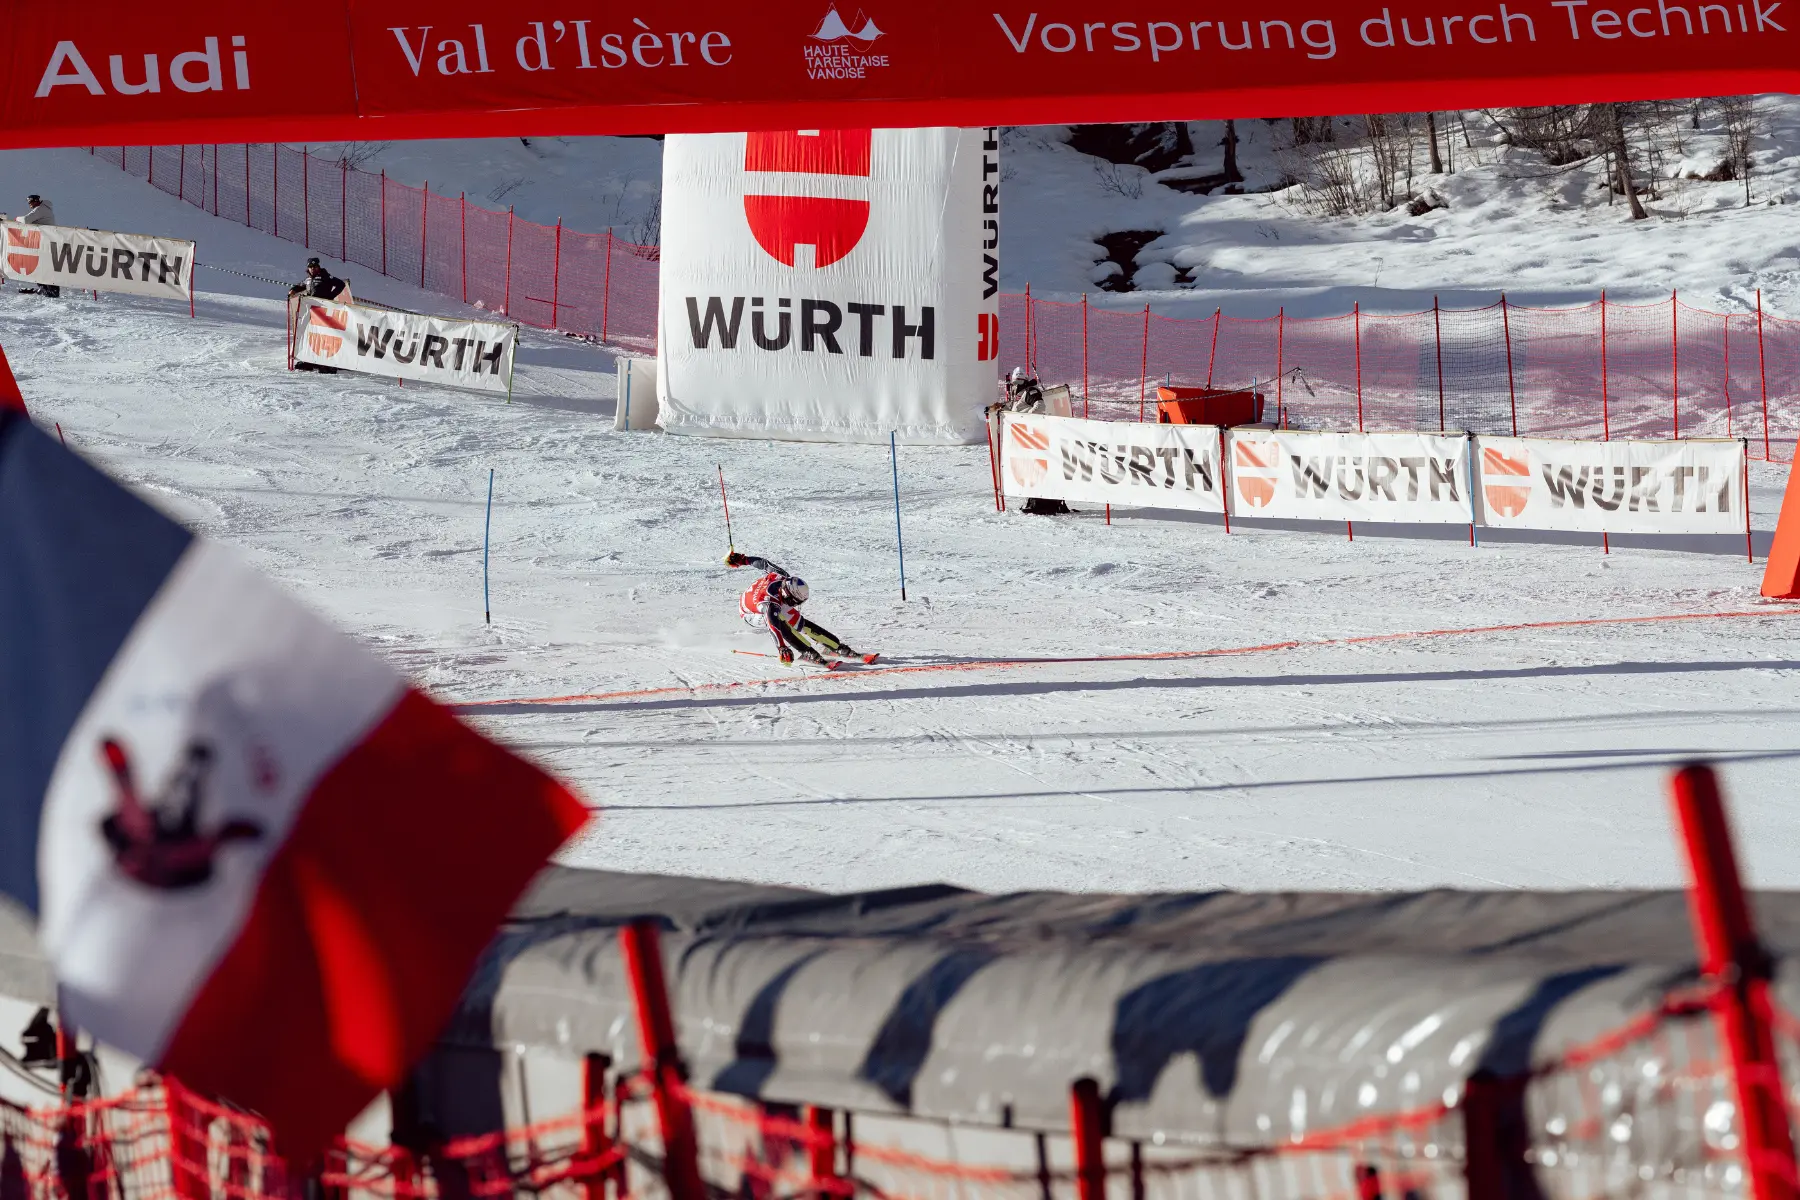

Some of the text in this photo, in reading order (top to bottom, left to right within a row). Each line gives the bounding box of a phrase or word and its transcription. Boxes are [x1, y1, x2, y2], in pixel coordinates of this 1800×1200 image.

[387, 18, 733, 77] Val d’Isère
[803, 44, 850, 57] HAUTE
[993, 0, 1786, 62] Vorsprung durch Technik
[34, 35, 251, 98] Audi
[805, 54, 890, 69] TARENTAISE
[806, 66, 866, 80] VANOISE
[982, 126, 999, 300] WÜRTH
[50, 241, 183, 286] WÜRTH
[356, 322, 503, 375] WÜRTH
[685, 296, 935, 360] WÜRTH
[1060, 440, 1213, 492] WÜRTH
[1291, 455, 1460, 502] WÜRTH
